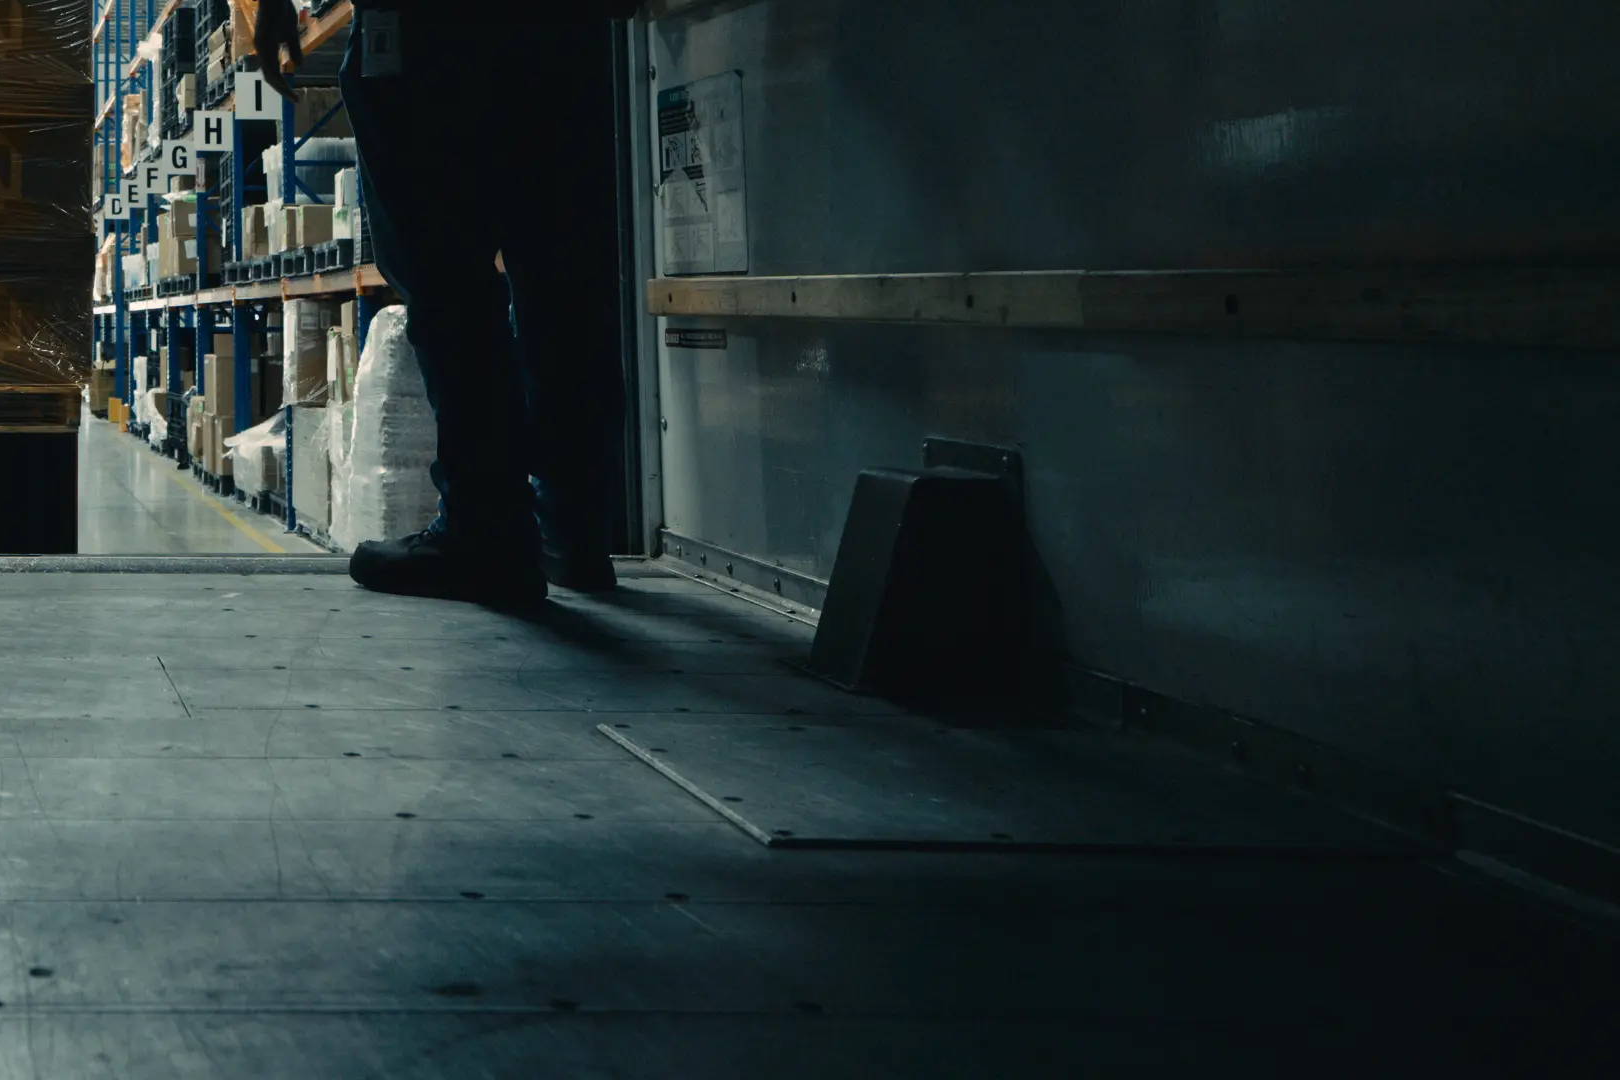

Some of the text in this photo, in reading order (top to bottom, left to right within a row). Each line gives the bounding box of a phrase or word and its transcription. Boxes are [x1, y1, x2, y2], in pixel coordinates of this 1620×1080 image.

[255, 80, 262, 111] I
[205, 118, 222, 144] H
[171, 146, 187, 169] G
[147, 167, 158, 188] F
[128, 185, 139, 203] E
[112, 198, 122, 215] D
